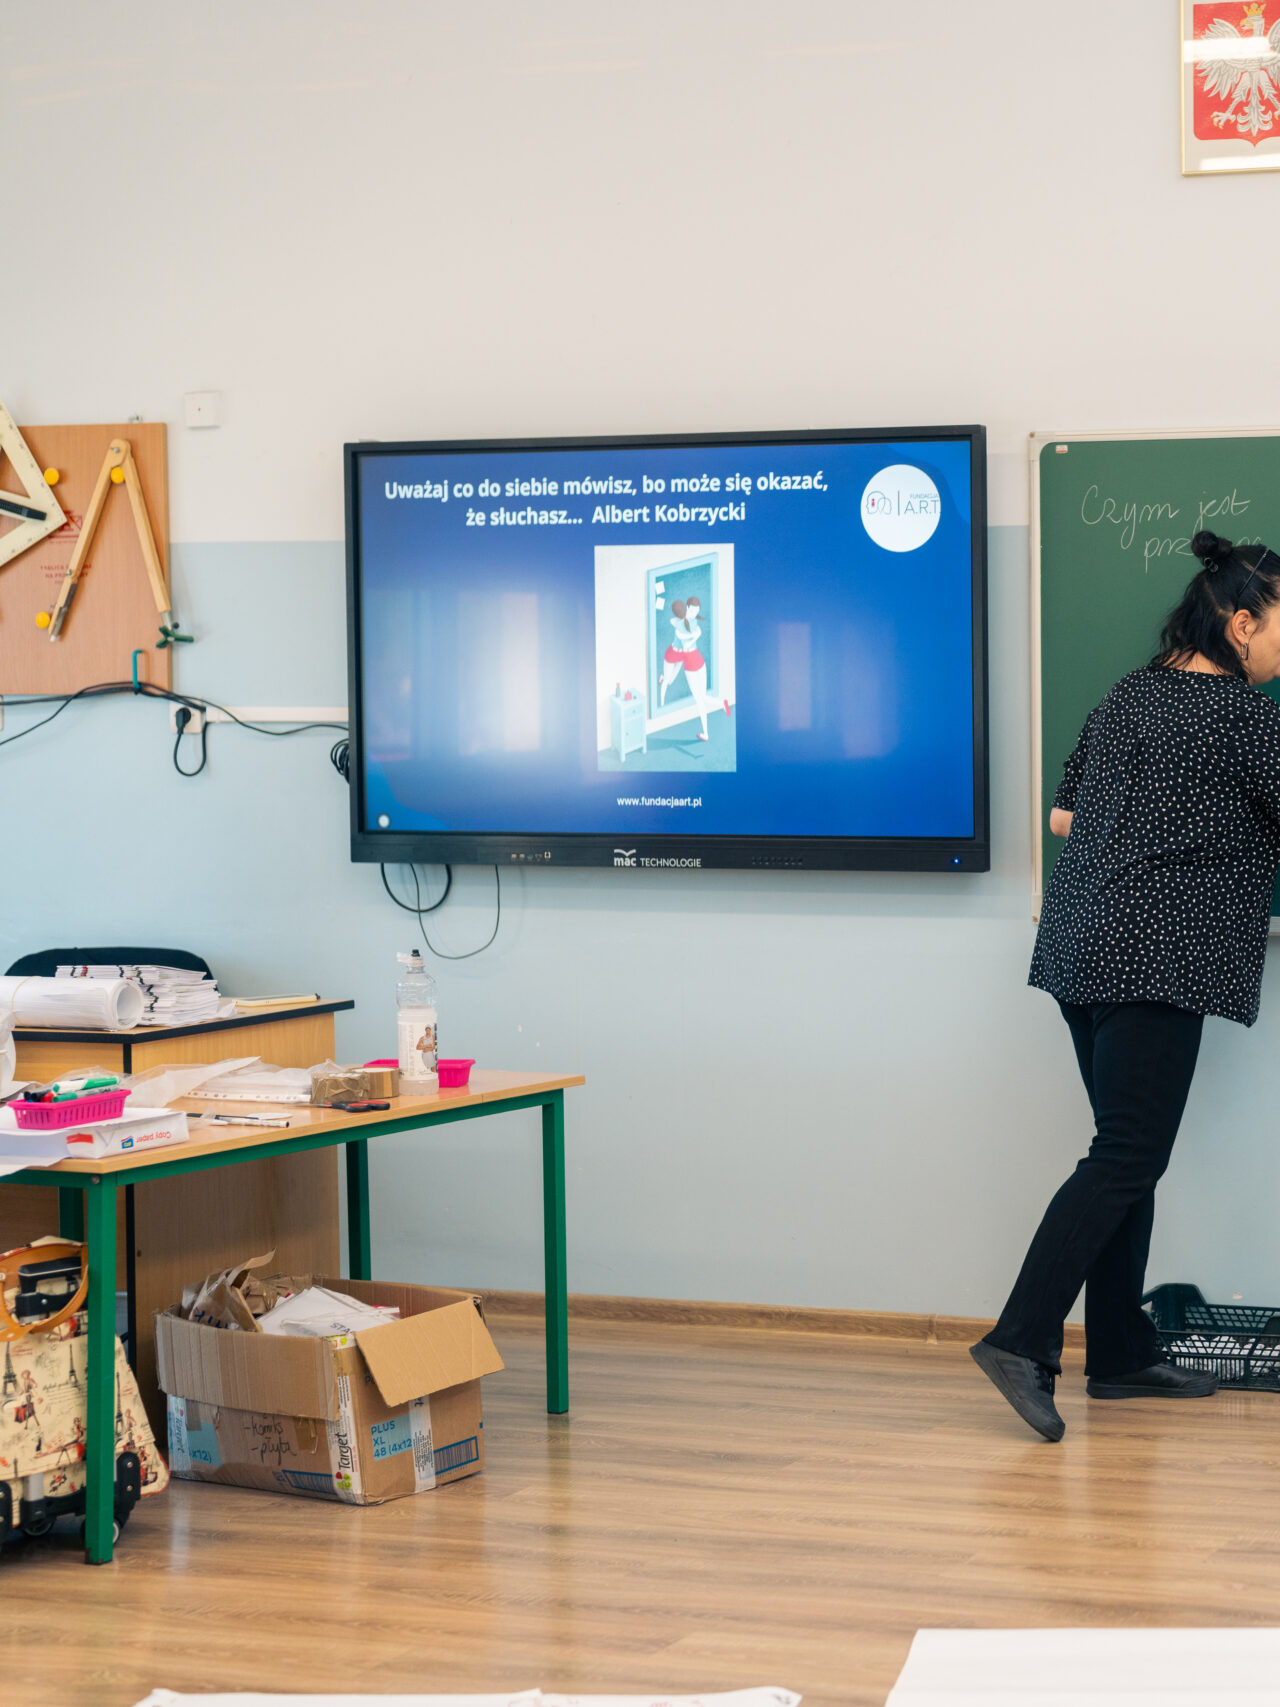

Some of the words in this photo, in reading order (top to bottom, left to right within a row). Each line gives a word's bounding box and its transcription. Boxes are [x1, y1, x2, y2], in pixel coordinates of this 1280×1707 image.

[384, 480, 449, 503] Uważaj
[453, 482, 474, 498] co
[478, 478, 501, 498] do
[505, 477, 559, 497] siebie
[563, 476, 637, 496] mówisz,
[642, 475, 666, 494] bo
[671, 474, 721, 492] może
[725, 473, 752, 496] się
[756, 471, 828, 492] okazać,
[465, 507, 486, 526] że
[489, 506, 583, 527] słuchasz...
[591, 505, 650, 524] Albert
[654, 502, 746, 527] Kobrzycki
[1081, 484, 1181, 550] Czym
[1192, 487, 1251, 538] jest
[616, 796, 702, 809] www.fundacjaart.pl
[640, 857, 702, 868] TECHNOLOGIE
[371, 1420, 396, 1435] PLUS
[373, 1437, 386, 1447] XL
[338, 1432, 351, 1471] Target
[374, 1447, 387, 1457] 48
